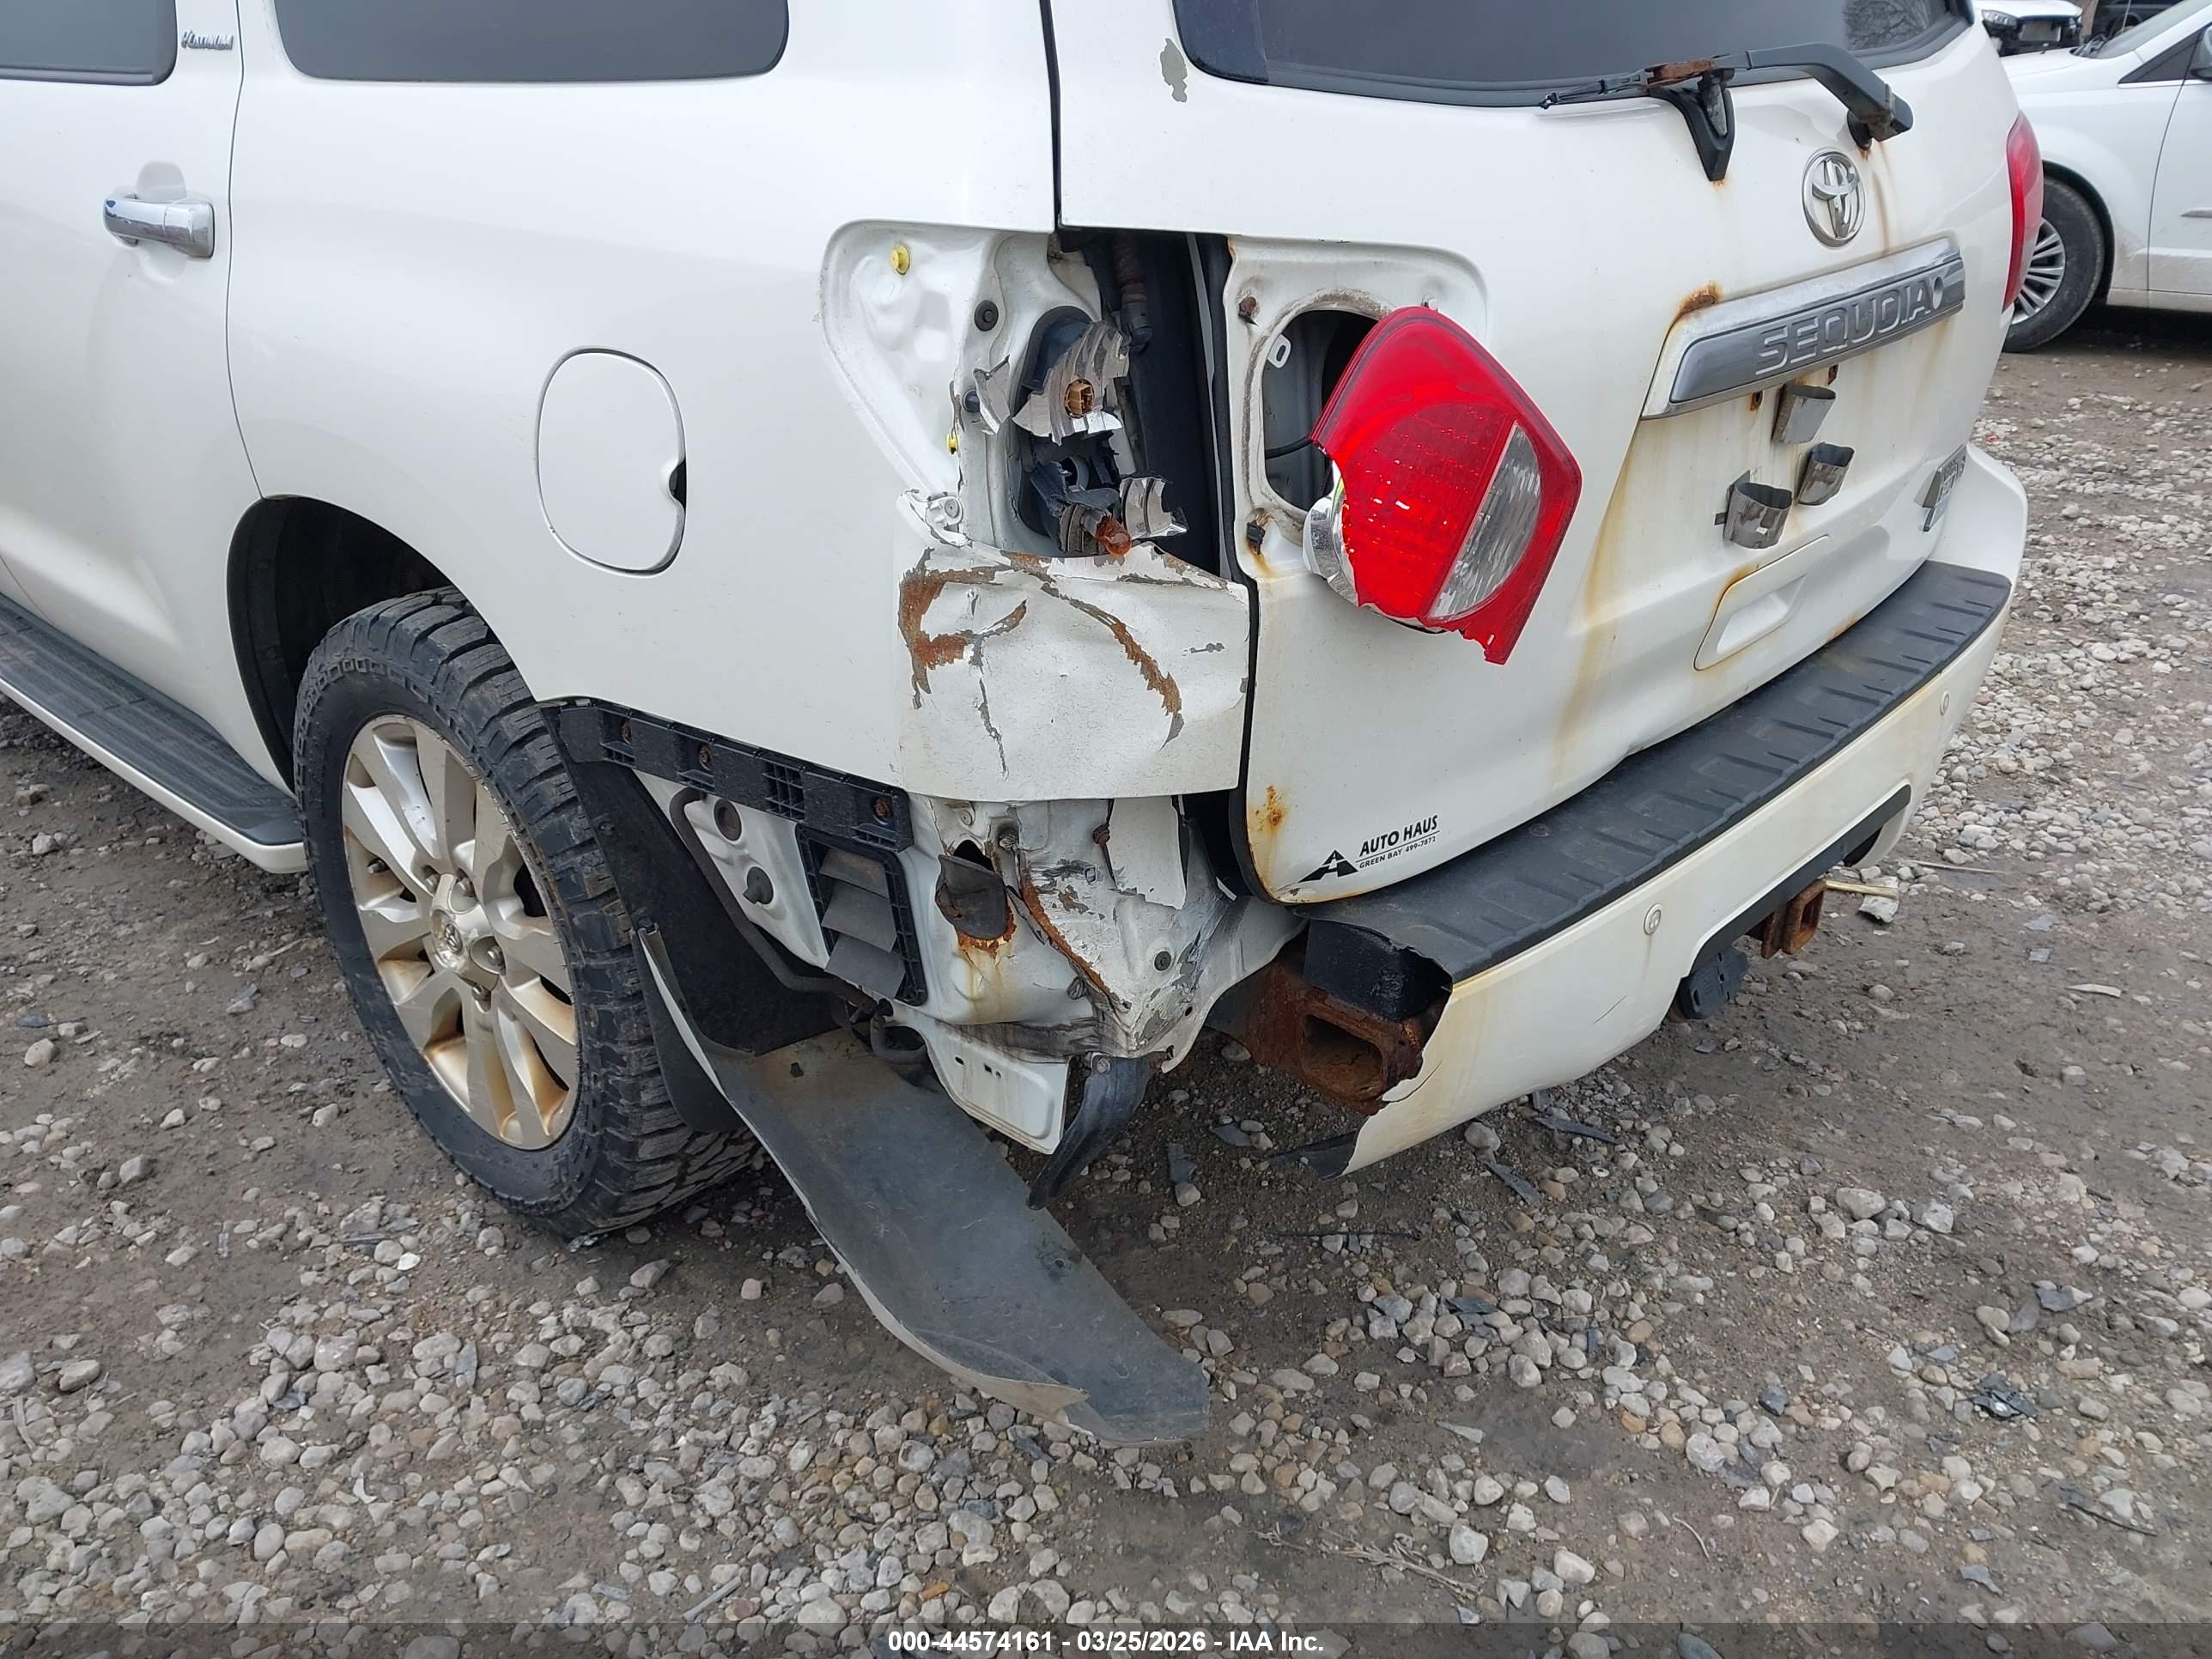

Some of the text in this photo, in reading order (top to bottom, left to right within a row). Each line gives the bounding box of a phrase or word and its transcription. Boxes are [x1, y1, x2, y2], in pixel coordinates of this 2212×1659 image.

[1755, 279, 1932, 375] SEQUOIA
[1359, 814, 1437, 857] AUTO HAUS
[1359, 836, 1437, 869] GREEN BAY 499-7872
